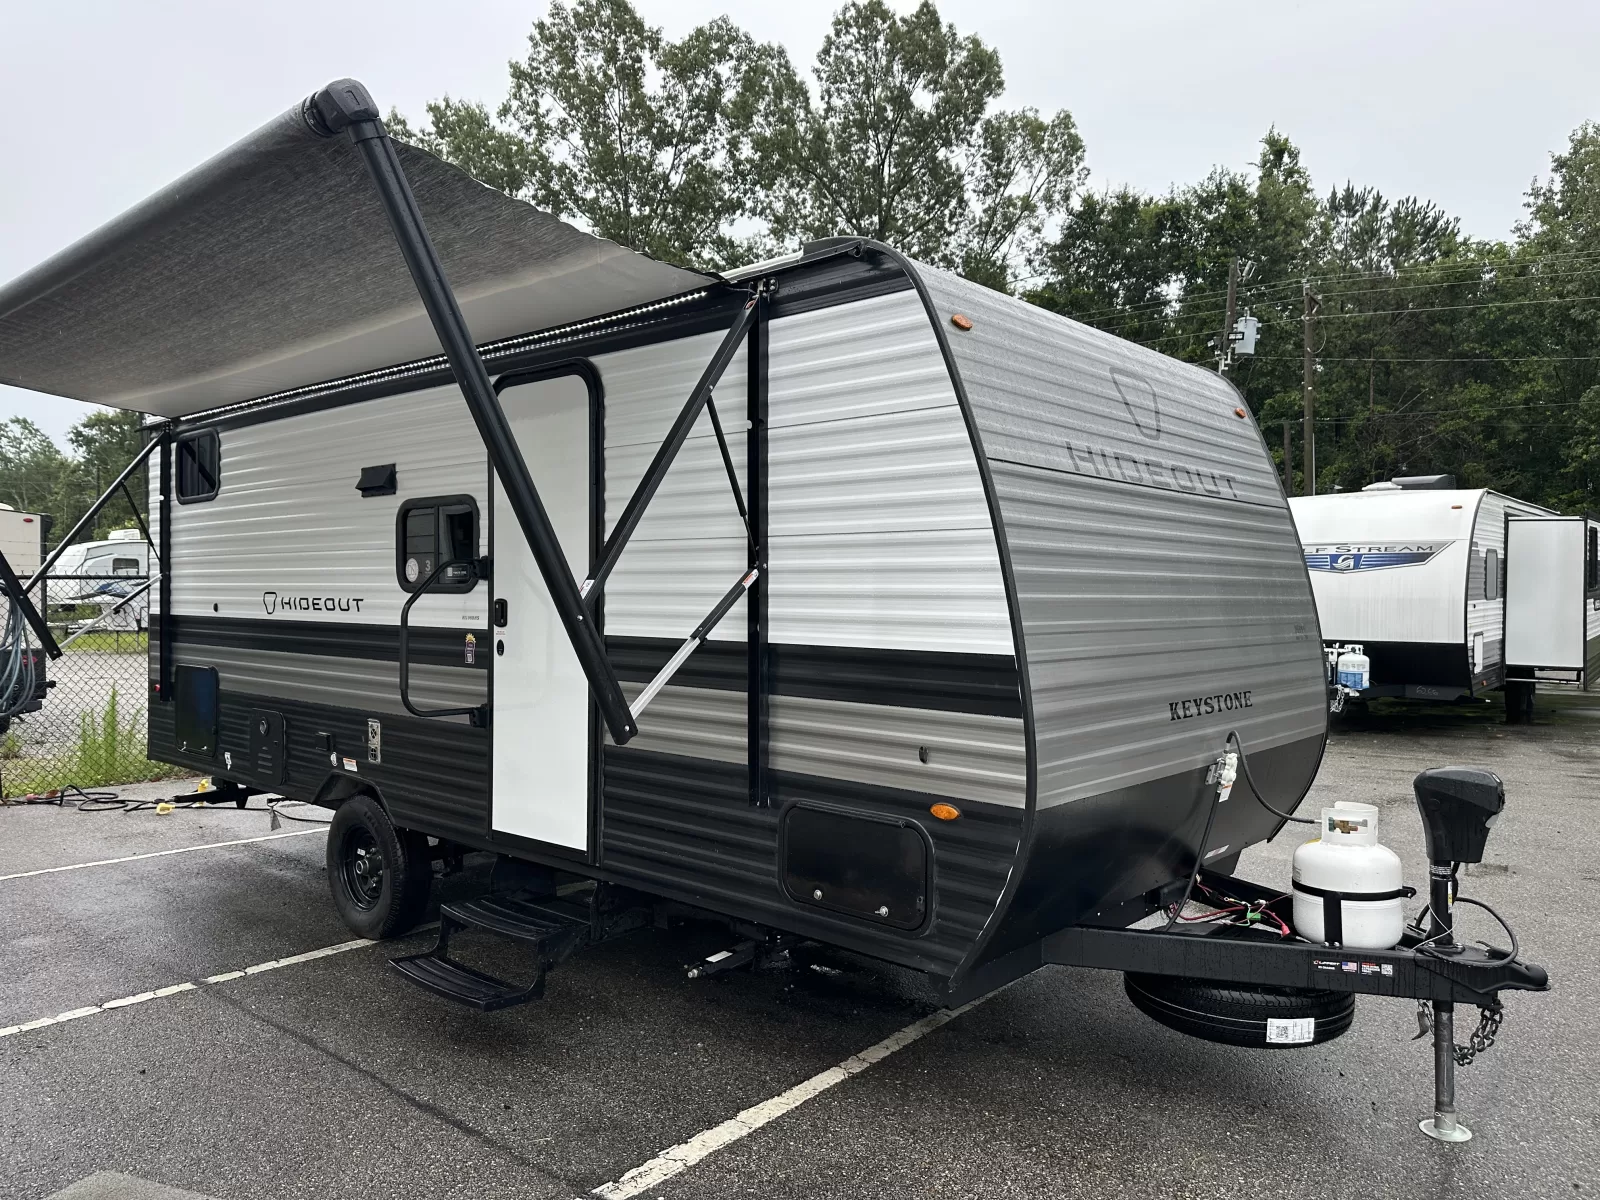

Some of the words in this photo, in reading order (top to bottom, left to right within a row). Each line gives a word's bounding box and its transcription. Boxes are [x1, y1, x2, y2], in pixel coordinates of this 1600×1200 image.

[1065, 441, 1238, 499] HIDEOUT
[281, 597, 364, 612] HIDEOUT
[1168, 691, 1253, 721] KEYSTONE
